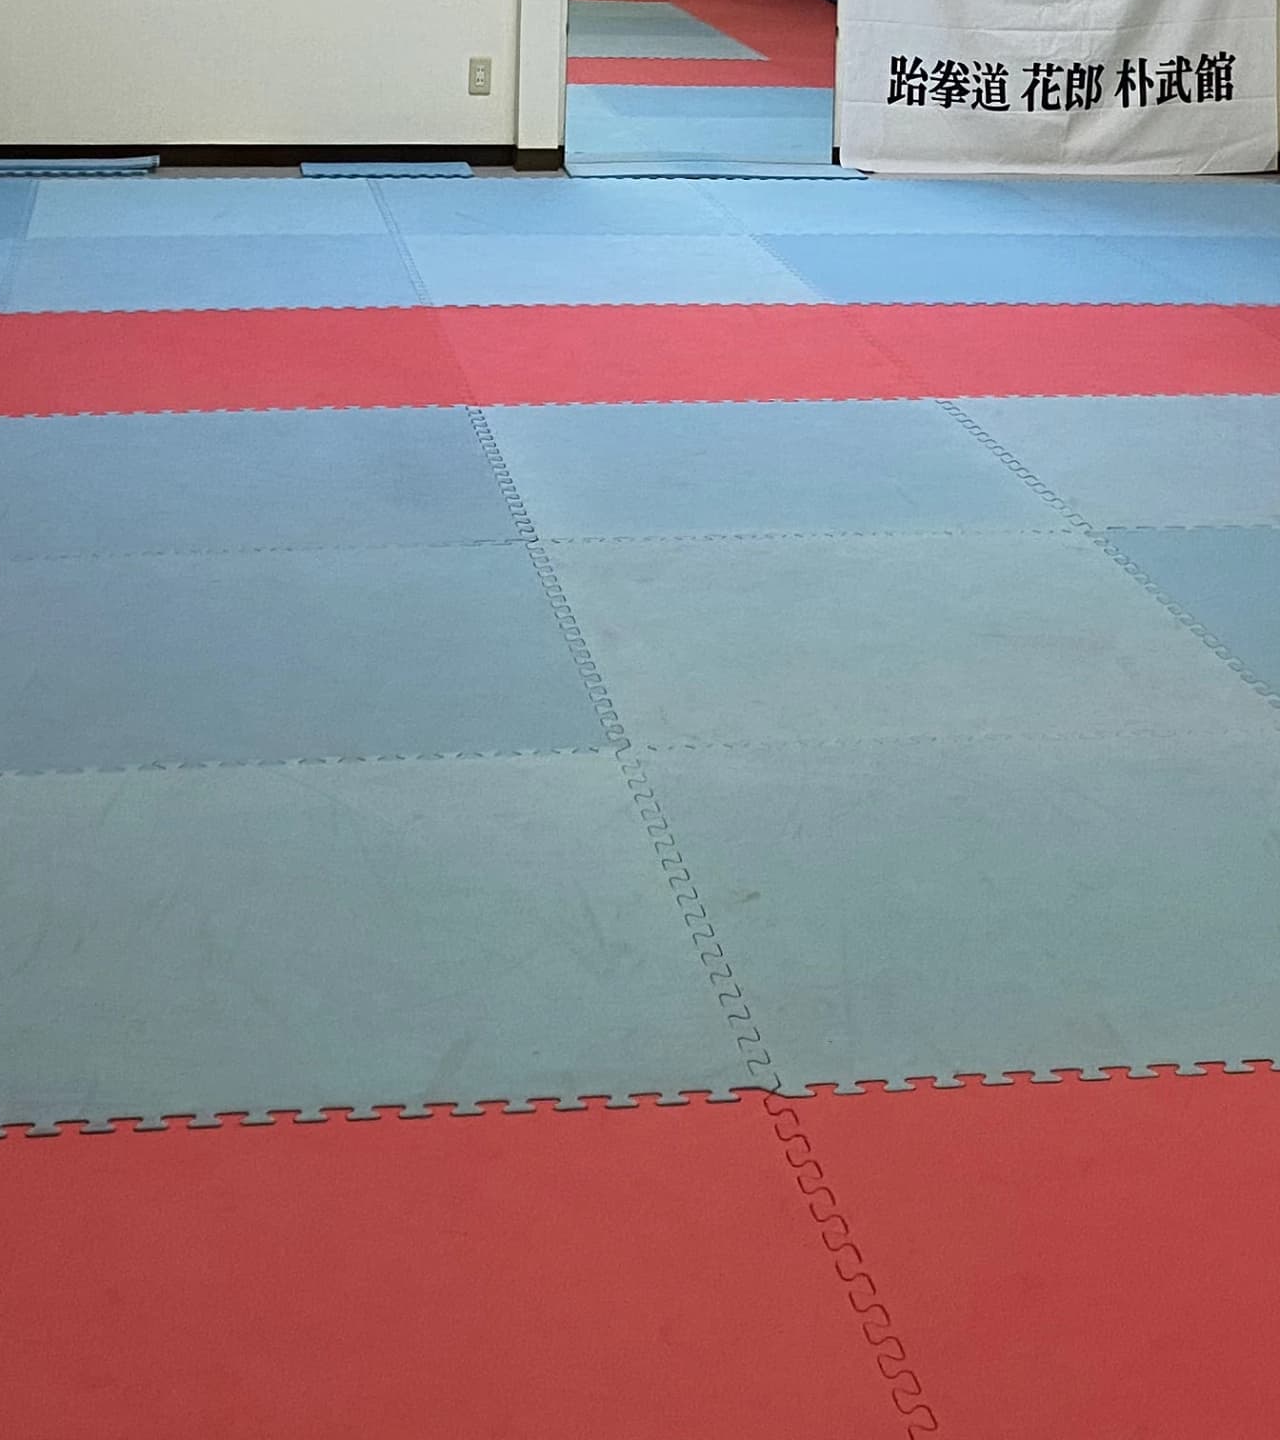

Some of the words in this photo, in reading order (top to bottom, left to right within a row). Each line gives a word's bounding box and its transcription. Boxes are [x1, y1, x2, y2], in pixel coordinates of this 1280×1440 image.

[887, 55, 1011, 111] 跆拳道
[1021, 62, 1105, 112] 花郎
[1114, 50, 1237, 109] 朴武館
